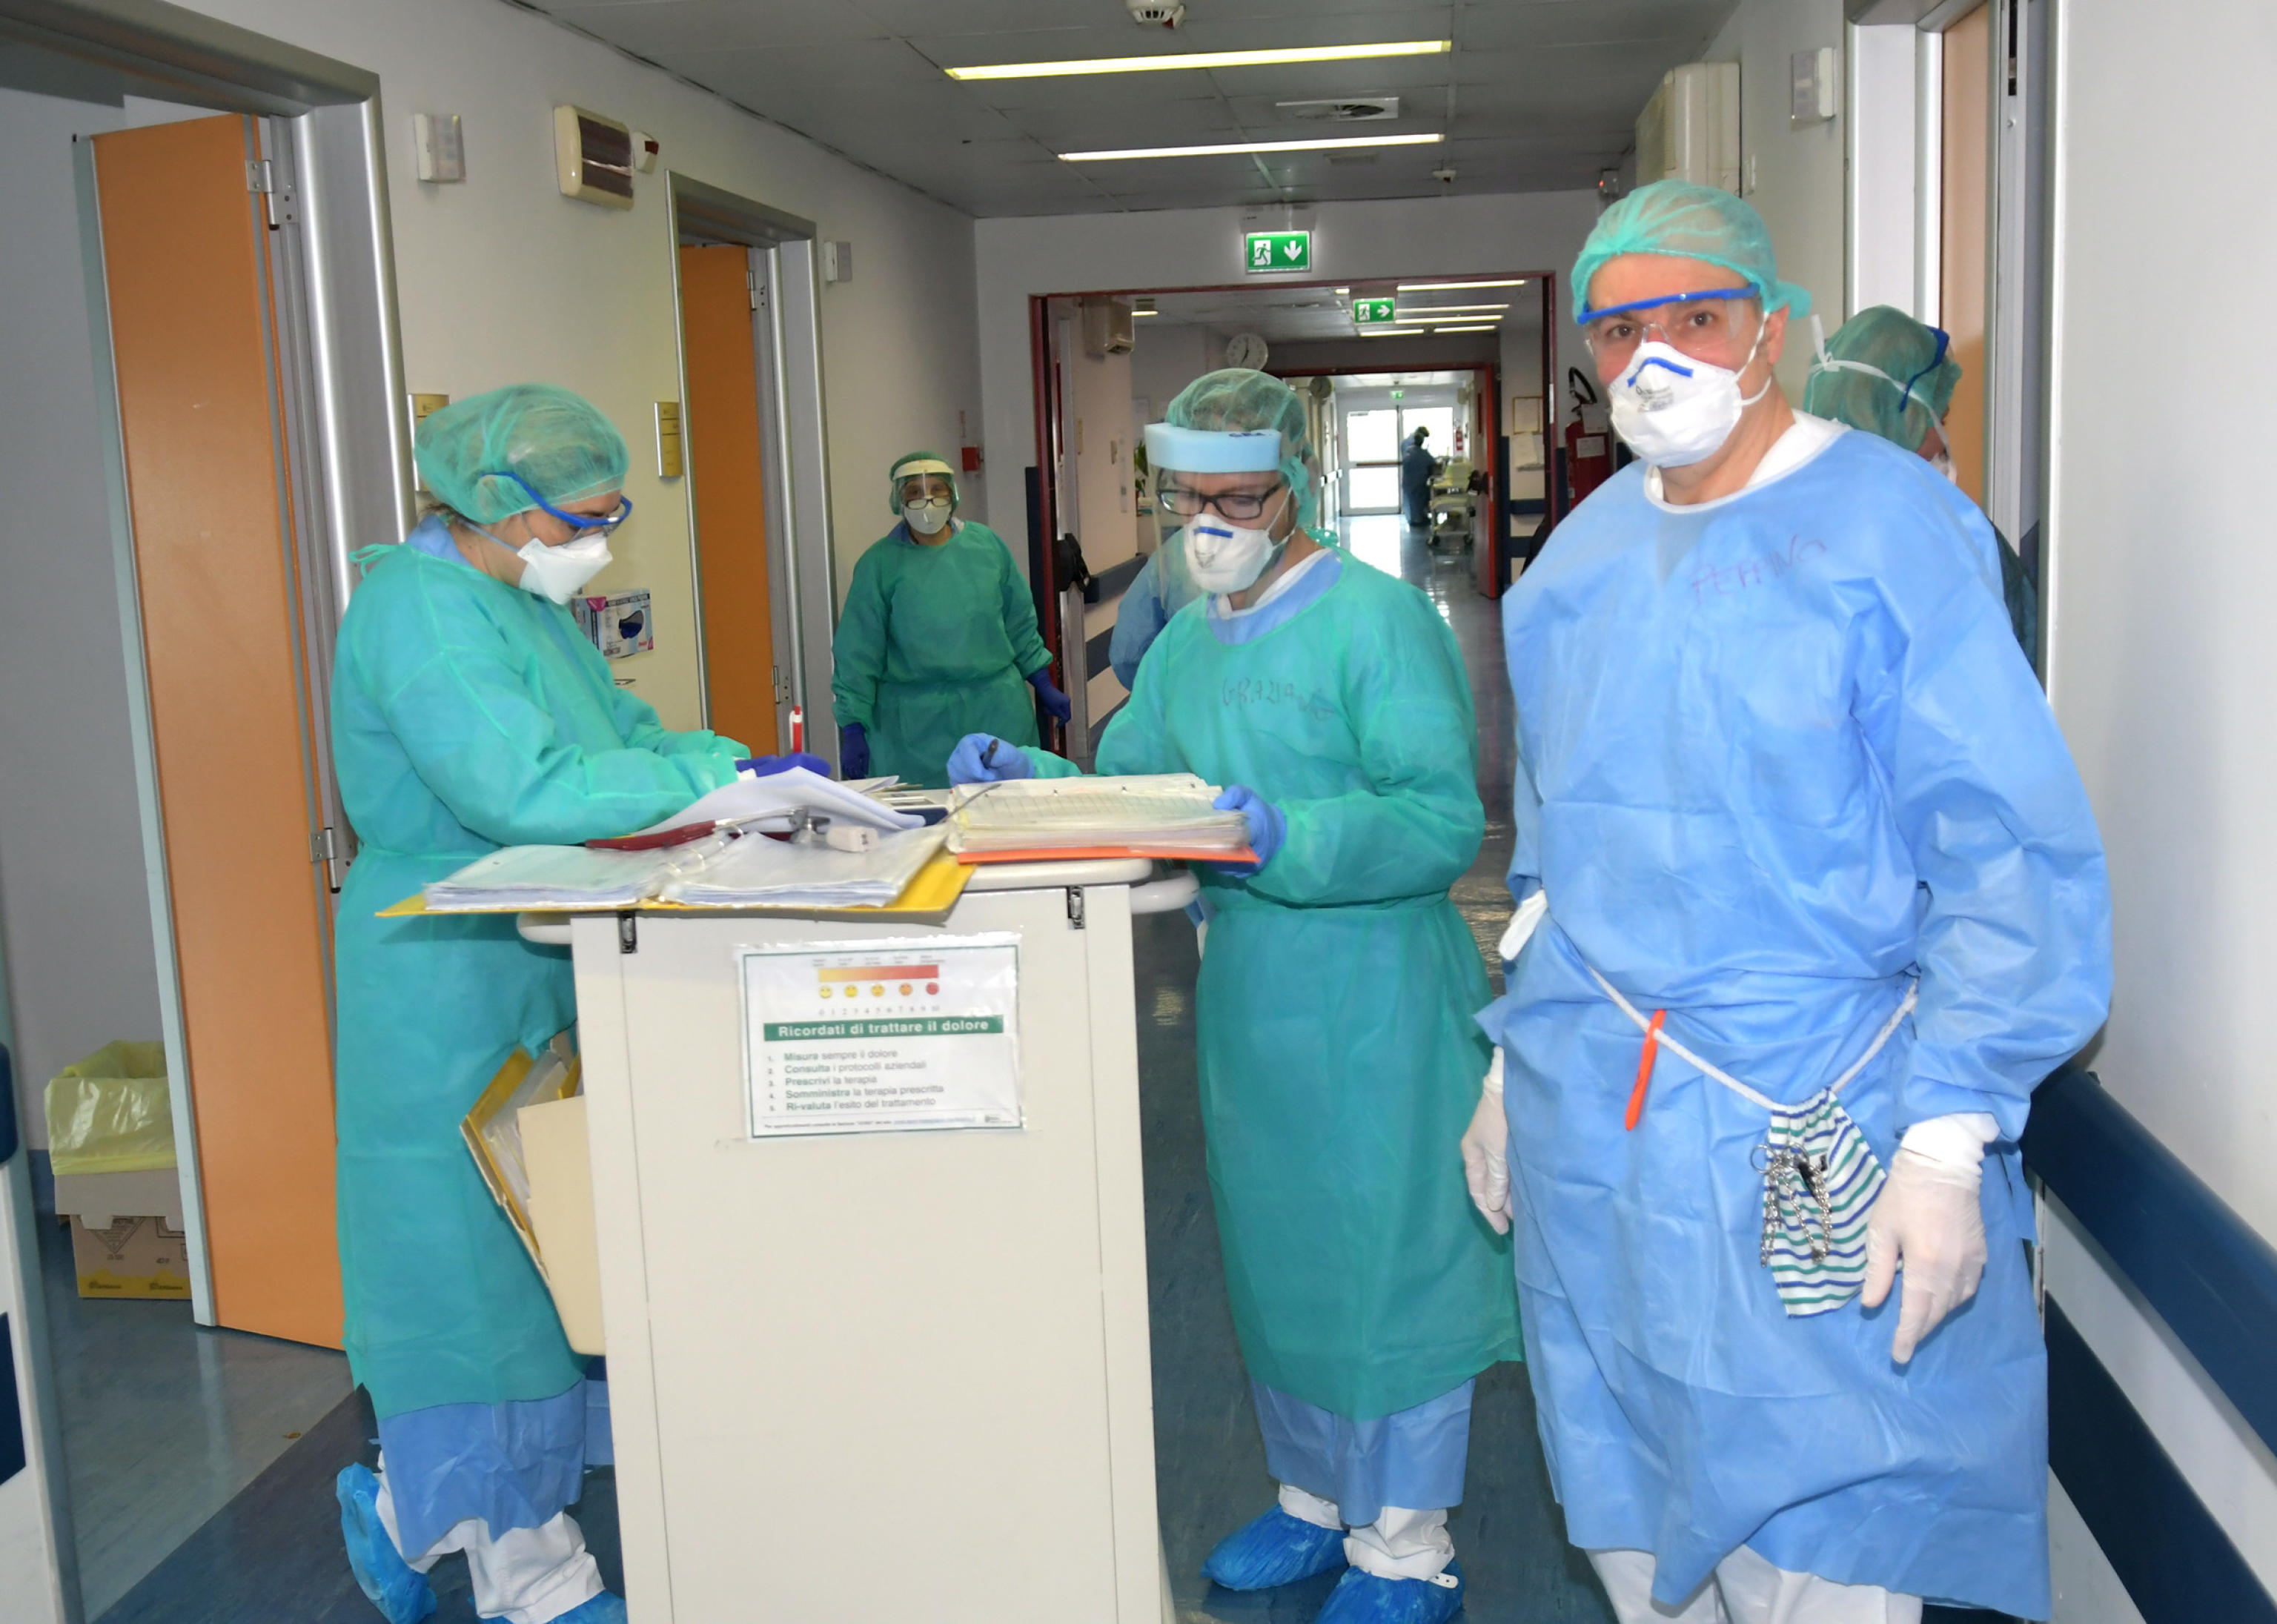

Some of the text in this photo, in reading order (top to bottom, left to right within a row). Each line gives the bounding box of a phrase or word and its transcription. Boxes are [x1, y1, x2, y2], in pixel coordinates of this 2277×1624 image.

[778, 1018, 989, 1037] Ricordati di trattare il dolore
[784, 1052, 818, 1061] Misura
[821, 1052, 857, 1061] sempre
[860, 1050, 865, 1058] il
[867, 1050, 898, 1058] dolore
[785, 1064, 830, 1073] Consulta
[838, 1062, 881, 1073] protocolli
[884, 1060, 927, 1070] aziendali
[785, 1077, 830, 1086] Prescrivi
[833, 1076, 841, 1084] la
[844, 1076, 877, 1084] terapia
[786, 1089, 850, 1098] Somministra
[864, 1087, 897, 1096] terapia
[900, 1085, 944, 1095] prescritta
[786, 1102, 831, 1110] Ri-valuta
[864, 1099, 878, 1108] del
[881, 1098, 936, 1107] trattamento
